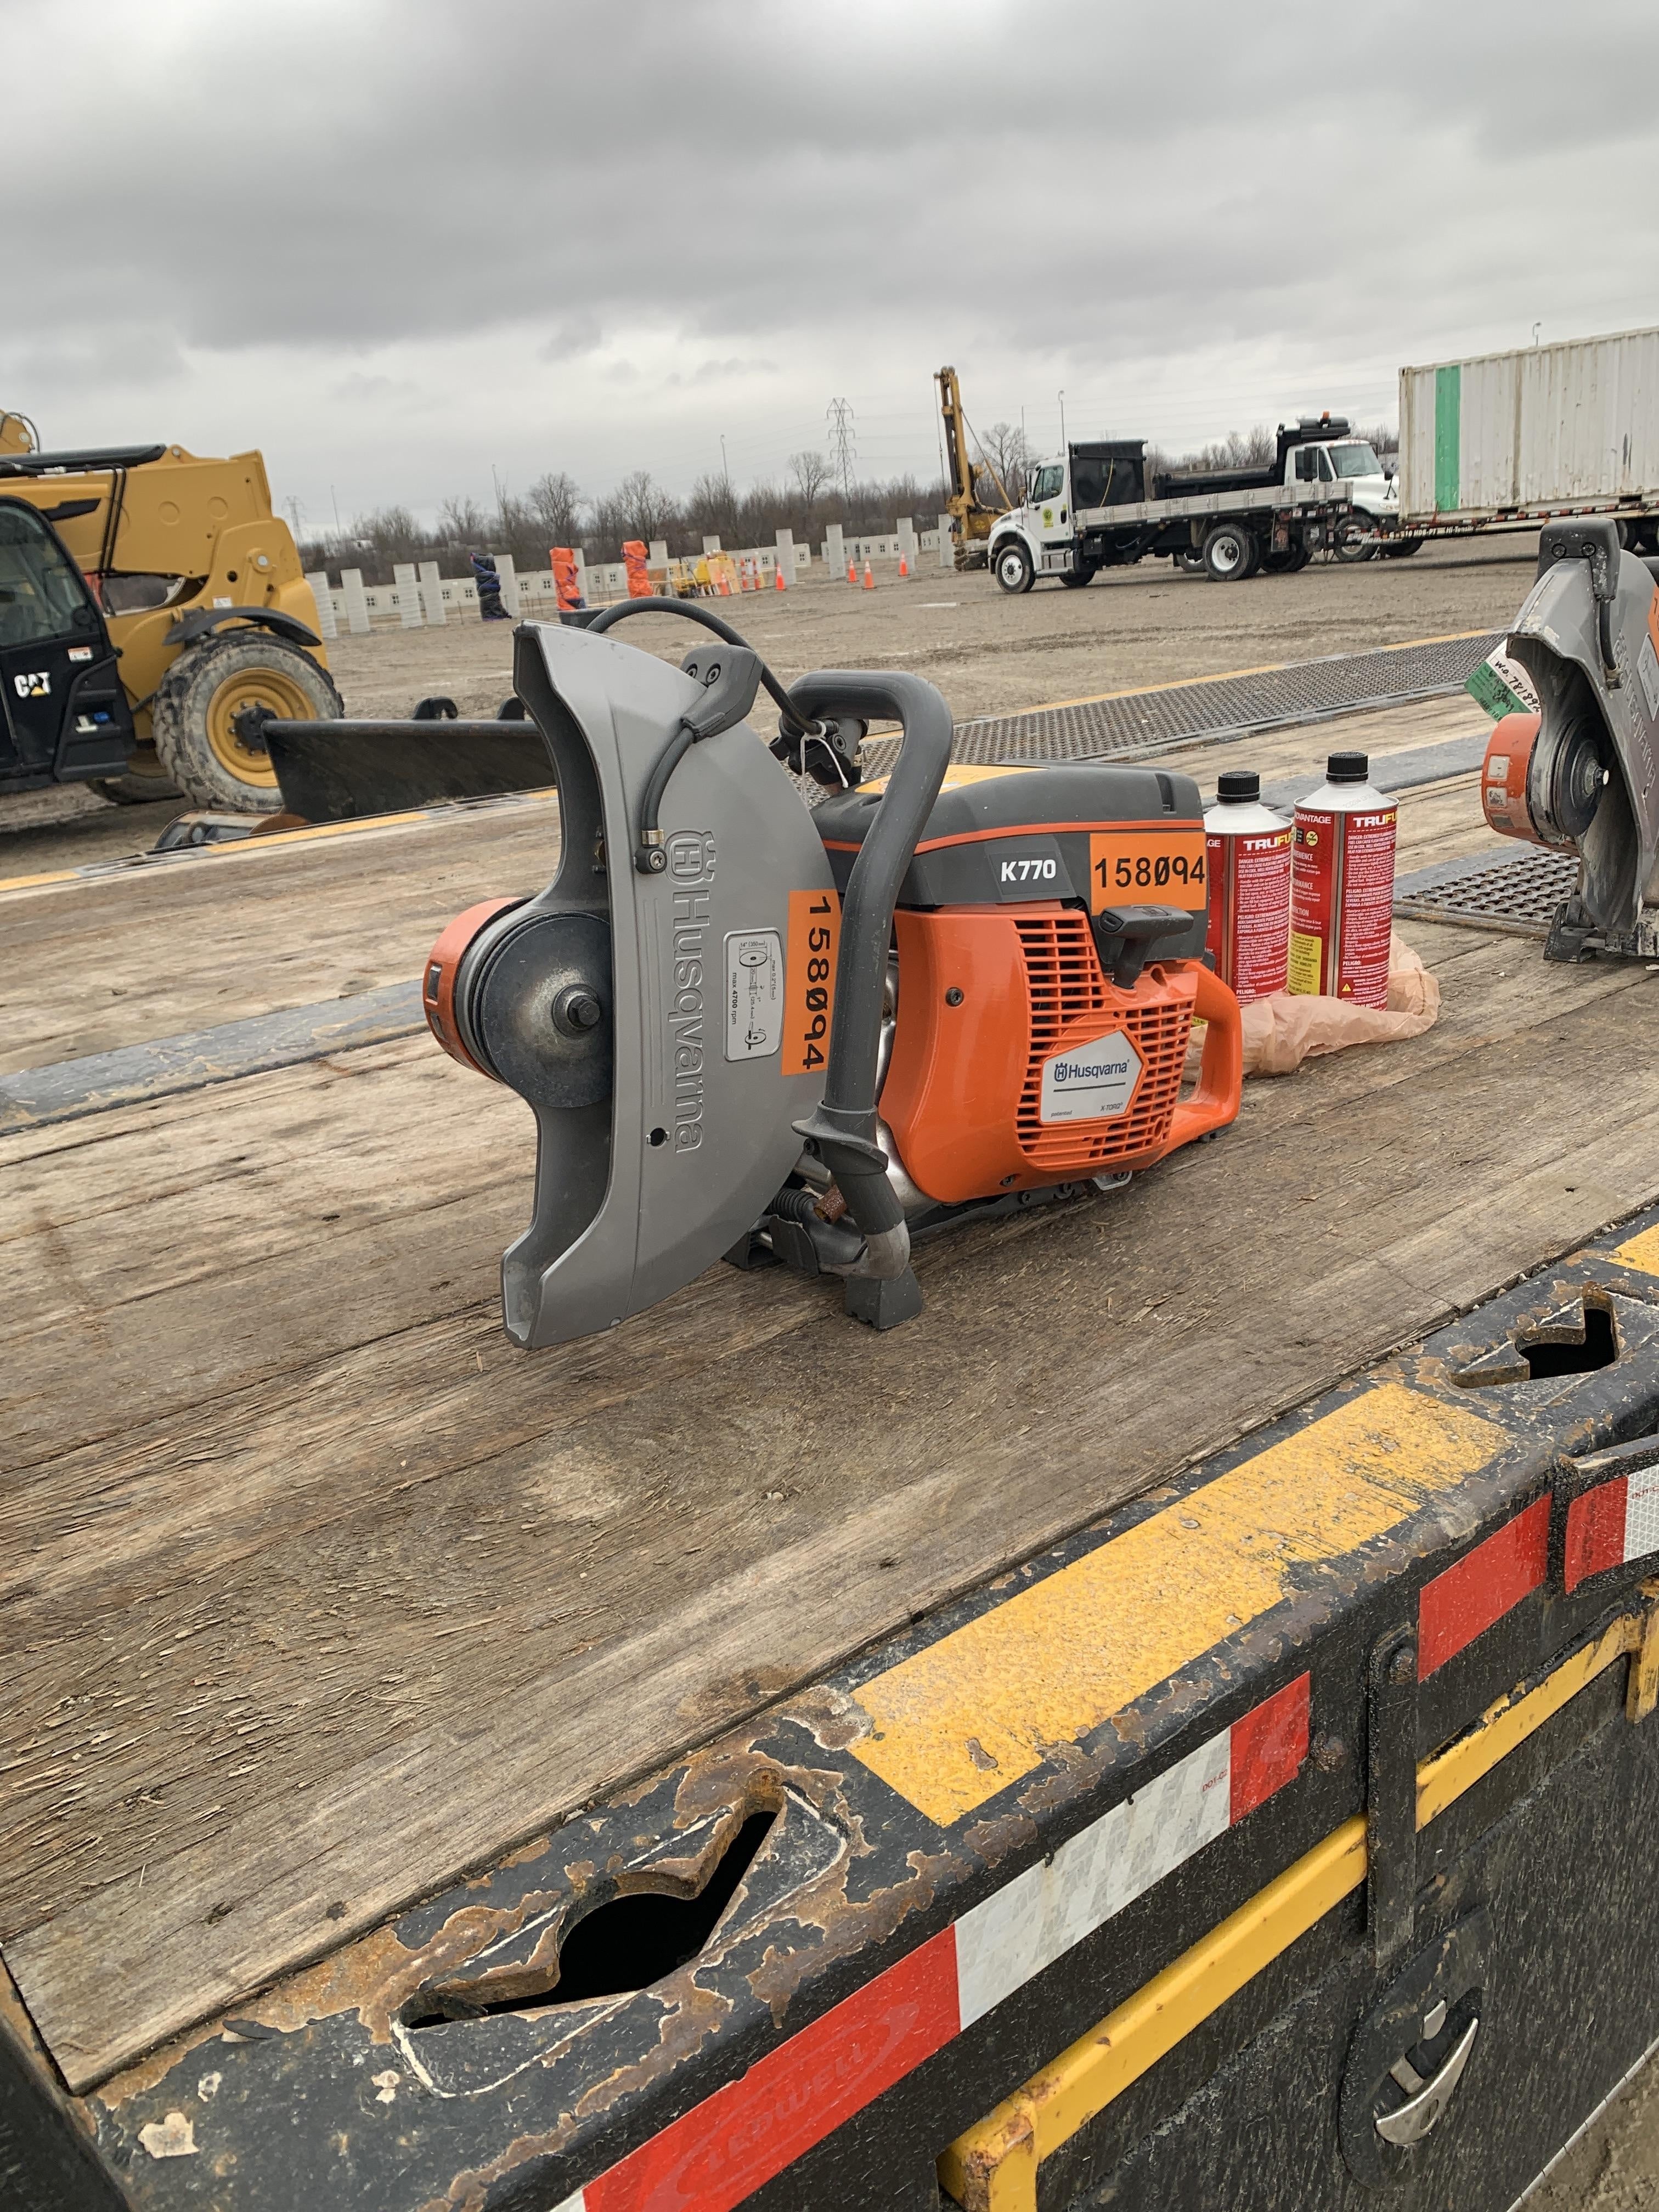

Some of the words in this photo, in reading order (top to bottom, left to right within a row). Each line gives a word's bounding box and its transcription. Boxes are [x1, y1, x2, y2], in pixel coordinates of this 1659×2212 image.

[14, 671, 51, 698] CAT
[1353, 812, 1396, 828] TRUFU
[1243, 832, 1291, 851] TRUFU
[1001, 859, 1057, 882] K770
[1094, 855, 1206, 888] 158094
[802, 895, 833, 1070] 158094
[668, 889, 710, 1154] Husqvarna
[1632, 1485, 1659, 1500] DOT-C
[707, 2042, 868, 2172] LEDWELL
